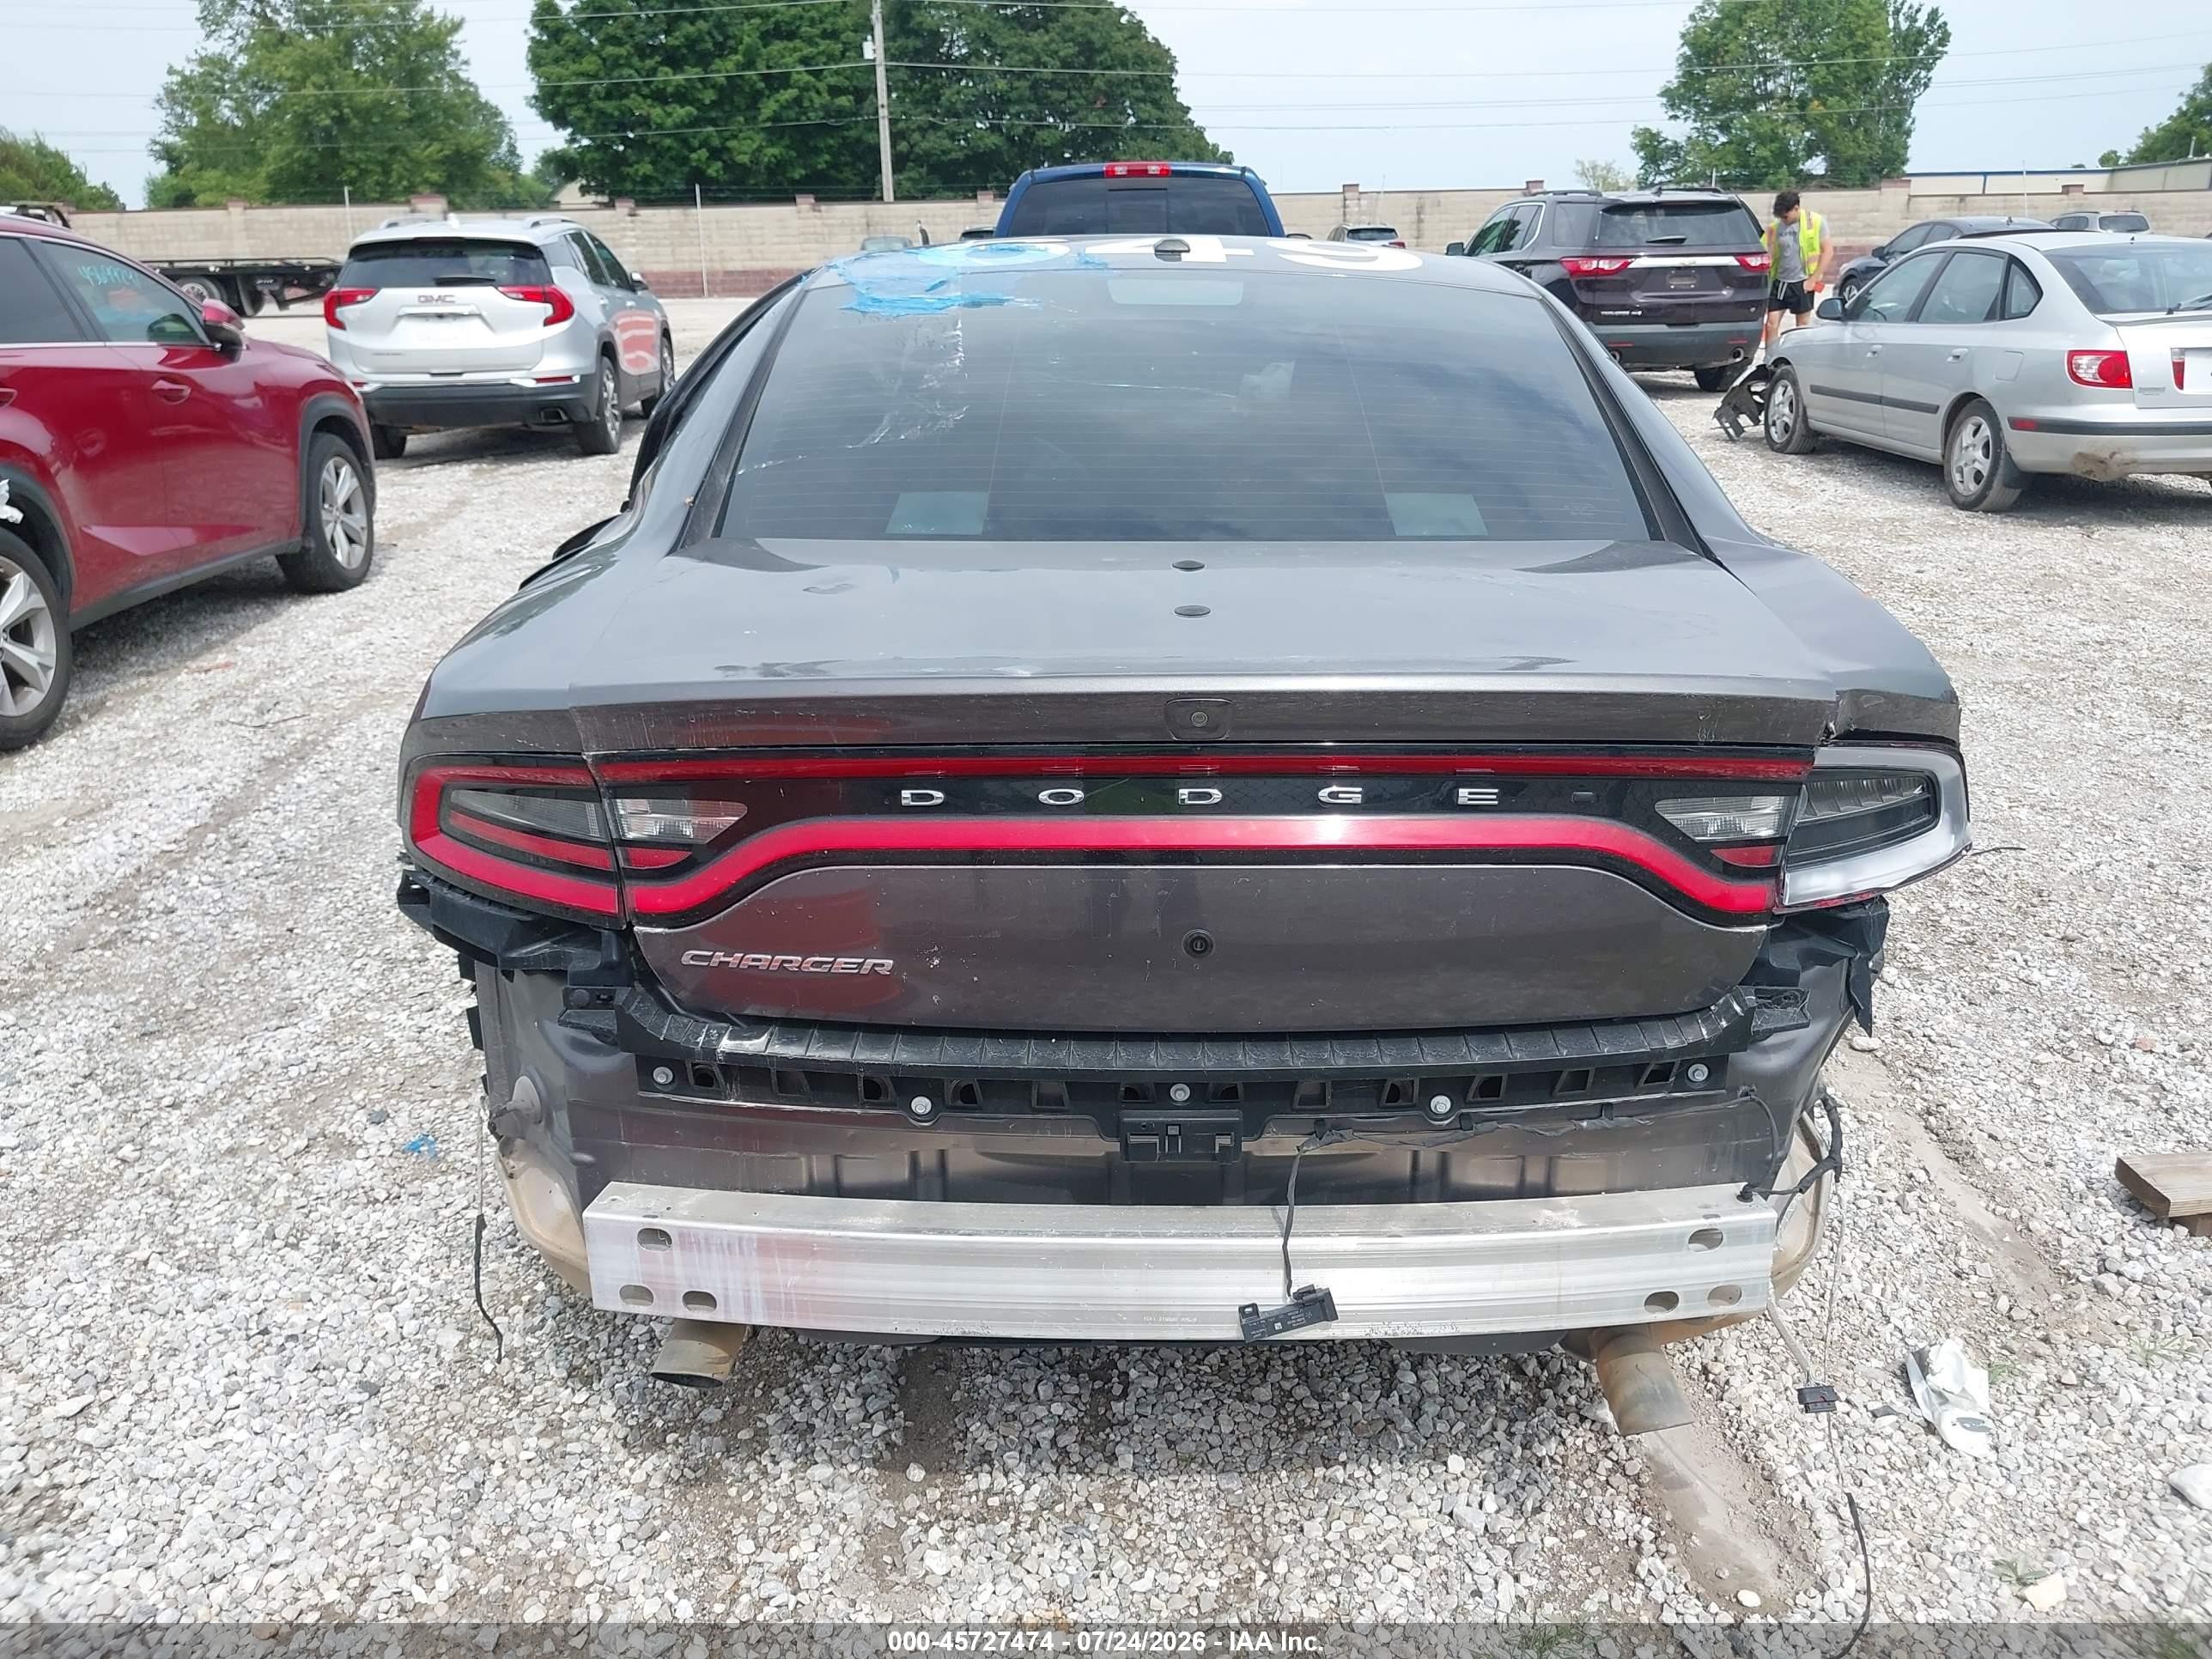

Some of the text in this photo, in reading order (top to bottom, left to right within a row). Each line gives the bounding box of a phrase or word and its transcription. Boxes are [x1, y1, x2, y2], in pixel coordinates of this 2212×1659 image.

[416, 295, 456, 303] GMC
[900, 786, 1499, 806] DODGE
[680, 950, 895, 975] CHARGER
